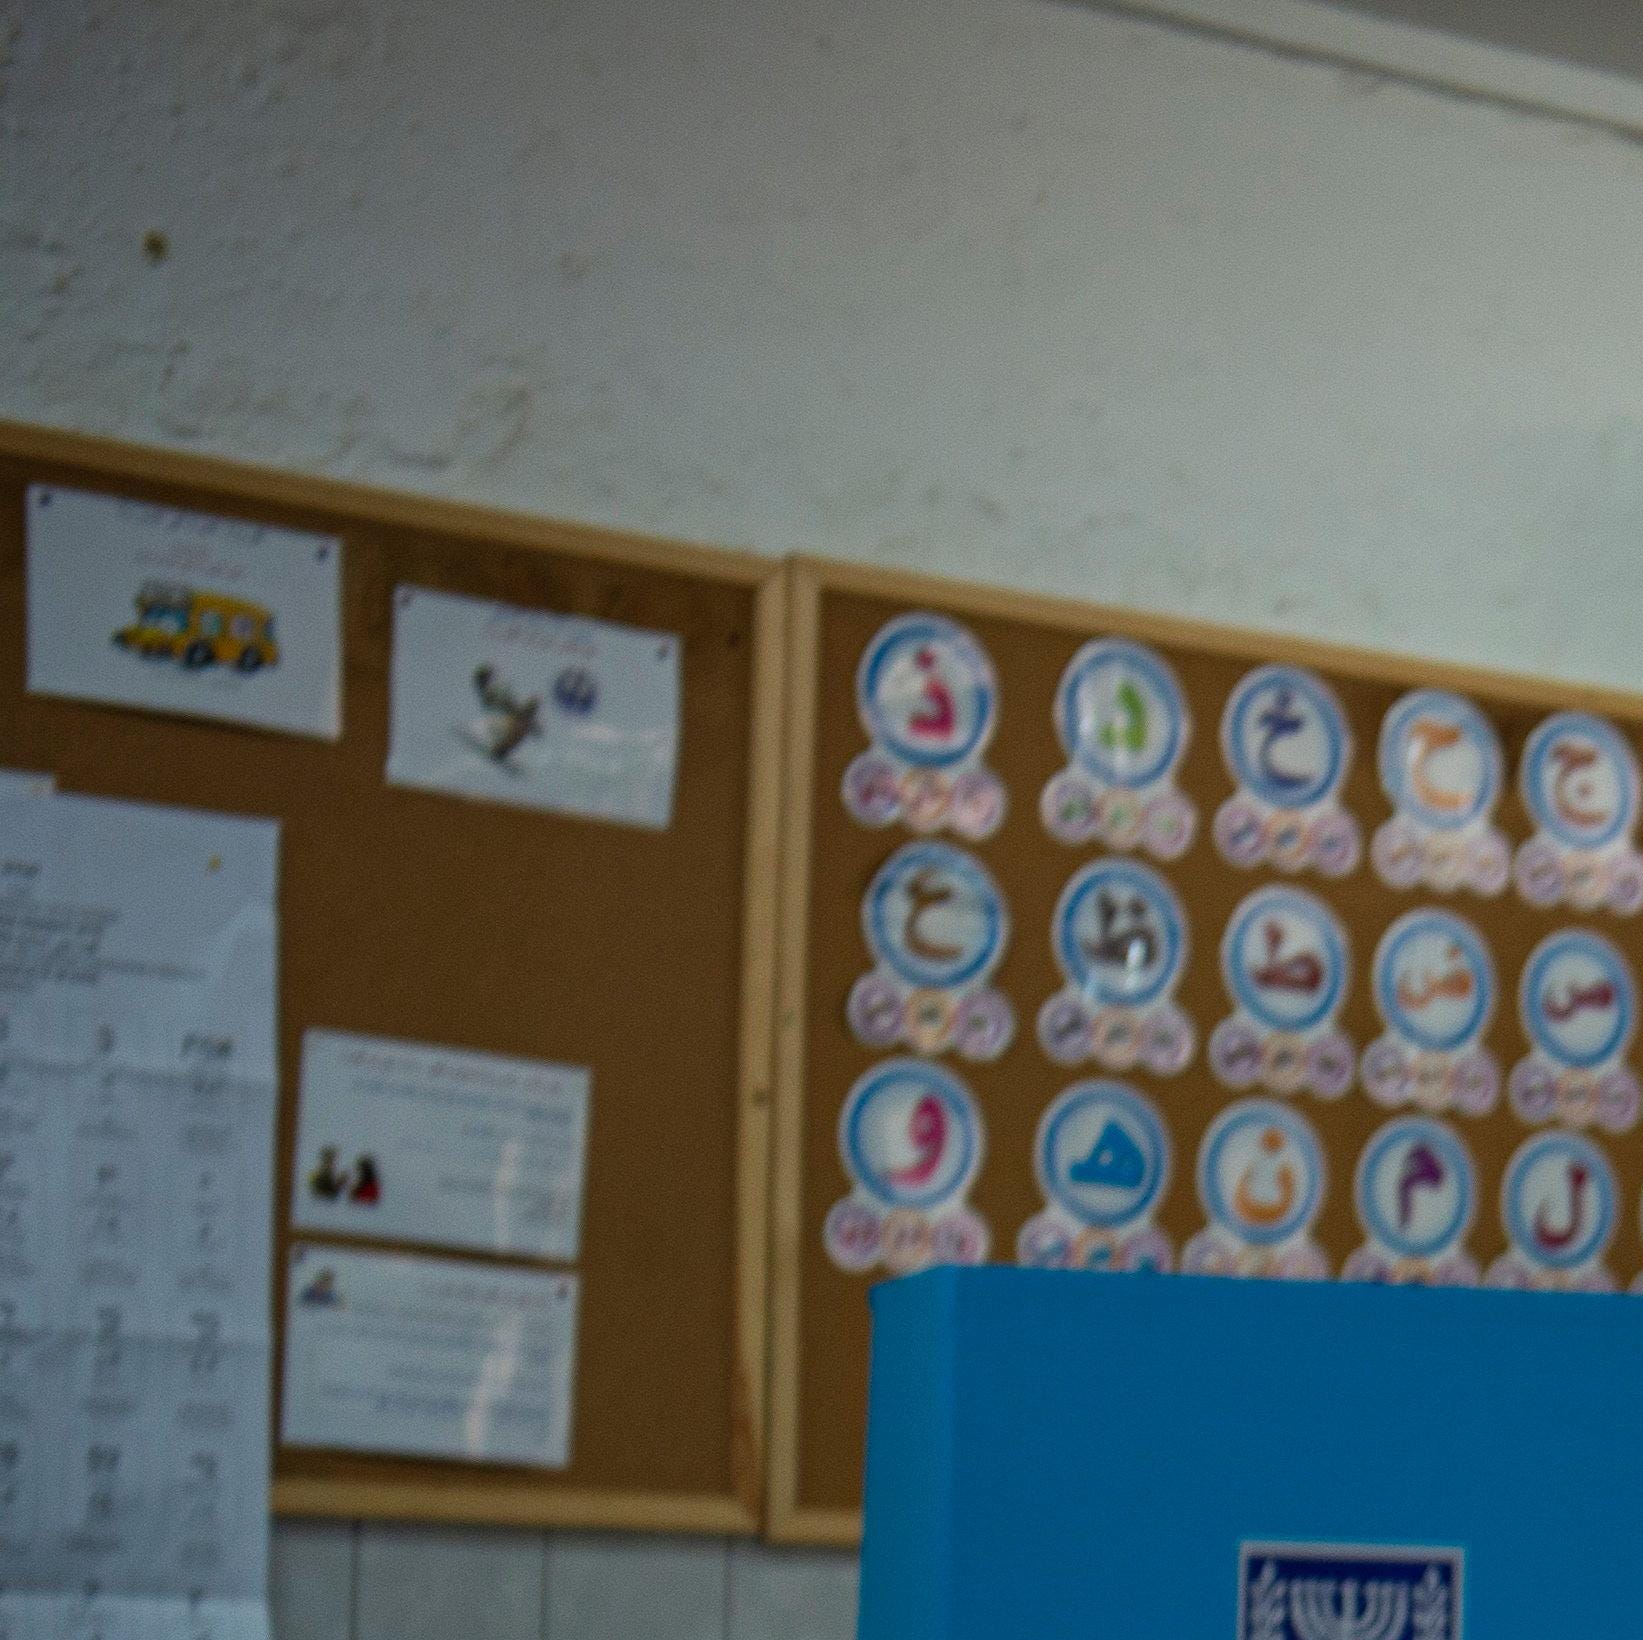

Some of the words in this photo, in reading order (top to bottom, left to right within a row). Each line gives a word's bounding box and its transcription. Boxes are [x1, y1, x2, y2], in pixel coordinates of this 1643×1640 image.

[907, 646, 955, 740] ذ
[1258, 687, 1313, 789] خ
[1411, 721, 1470, 810] ح
[1553, 742, 1599, 828] ج
[907, 867, 964, 962] ع
[1087, 889, 1157, 968] ظ
[1253, 920, 1322, 996] ط
[1397, 943, 1475, 1010] ض
[1544, 984, 1612, 1021] ص
[887, 1095, 947, 1187] و
[1234, 1127, 1295, 1224] ن
[1400, 1143, 1444, 1227] م
[1536, 1162, 1586, 1251] ل
